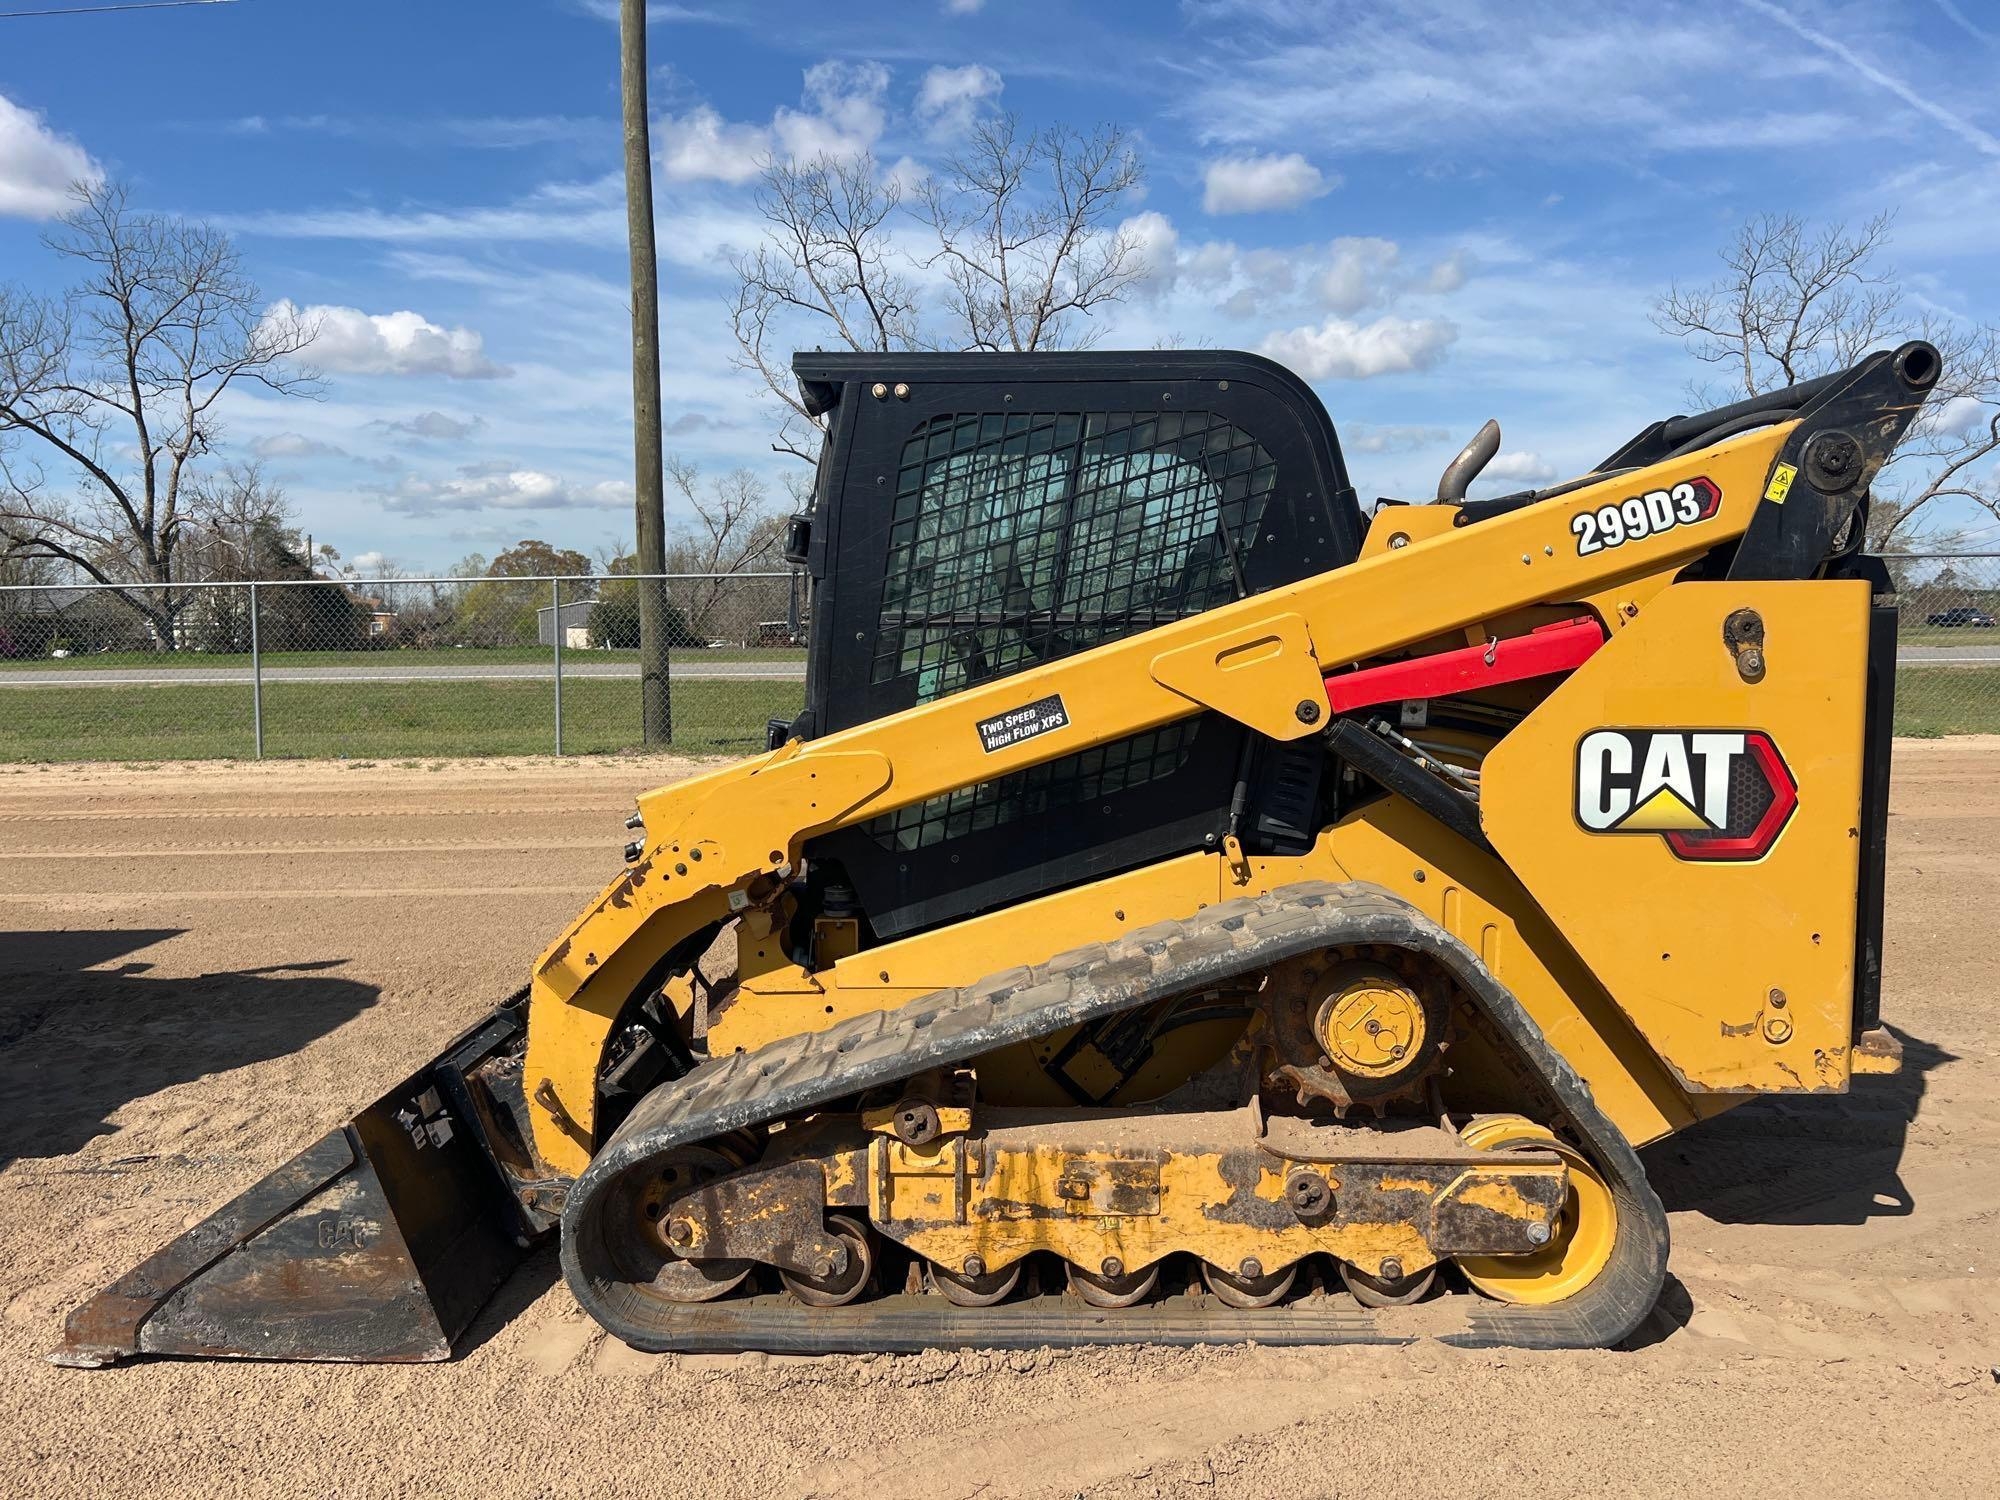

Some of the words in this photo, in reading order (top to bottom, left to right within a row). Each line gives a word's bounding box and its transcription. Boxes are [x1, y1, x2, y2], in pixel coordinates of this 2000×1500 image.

[1572, 483, 1700, 555] 299D3
[1041, 712, 1063, 730] XPS
[1579, 731, 1745, 830] CAT
[318, 1218, 371, 1248] CAT
